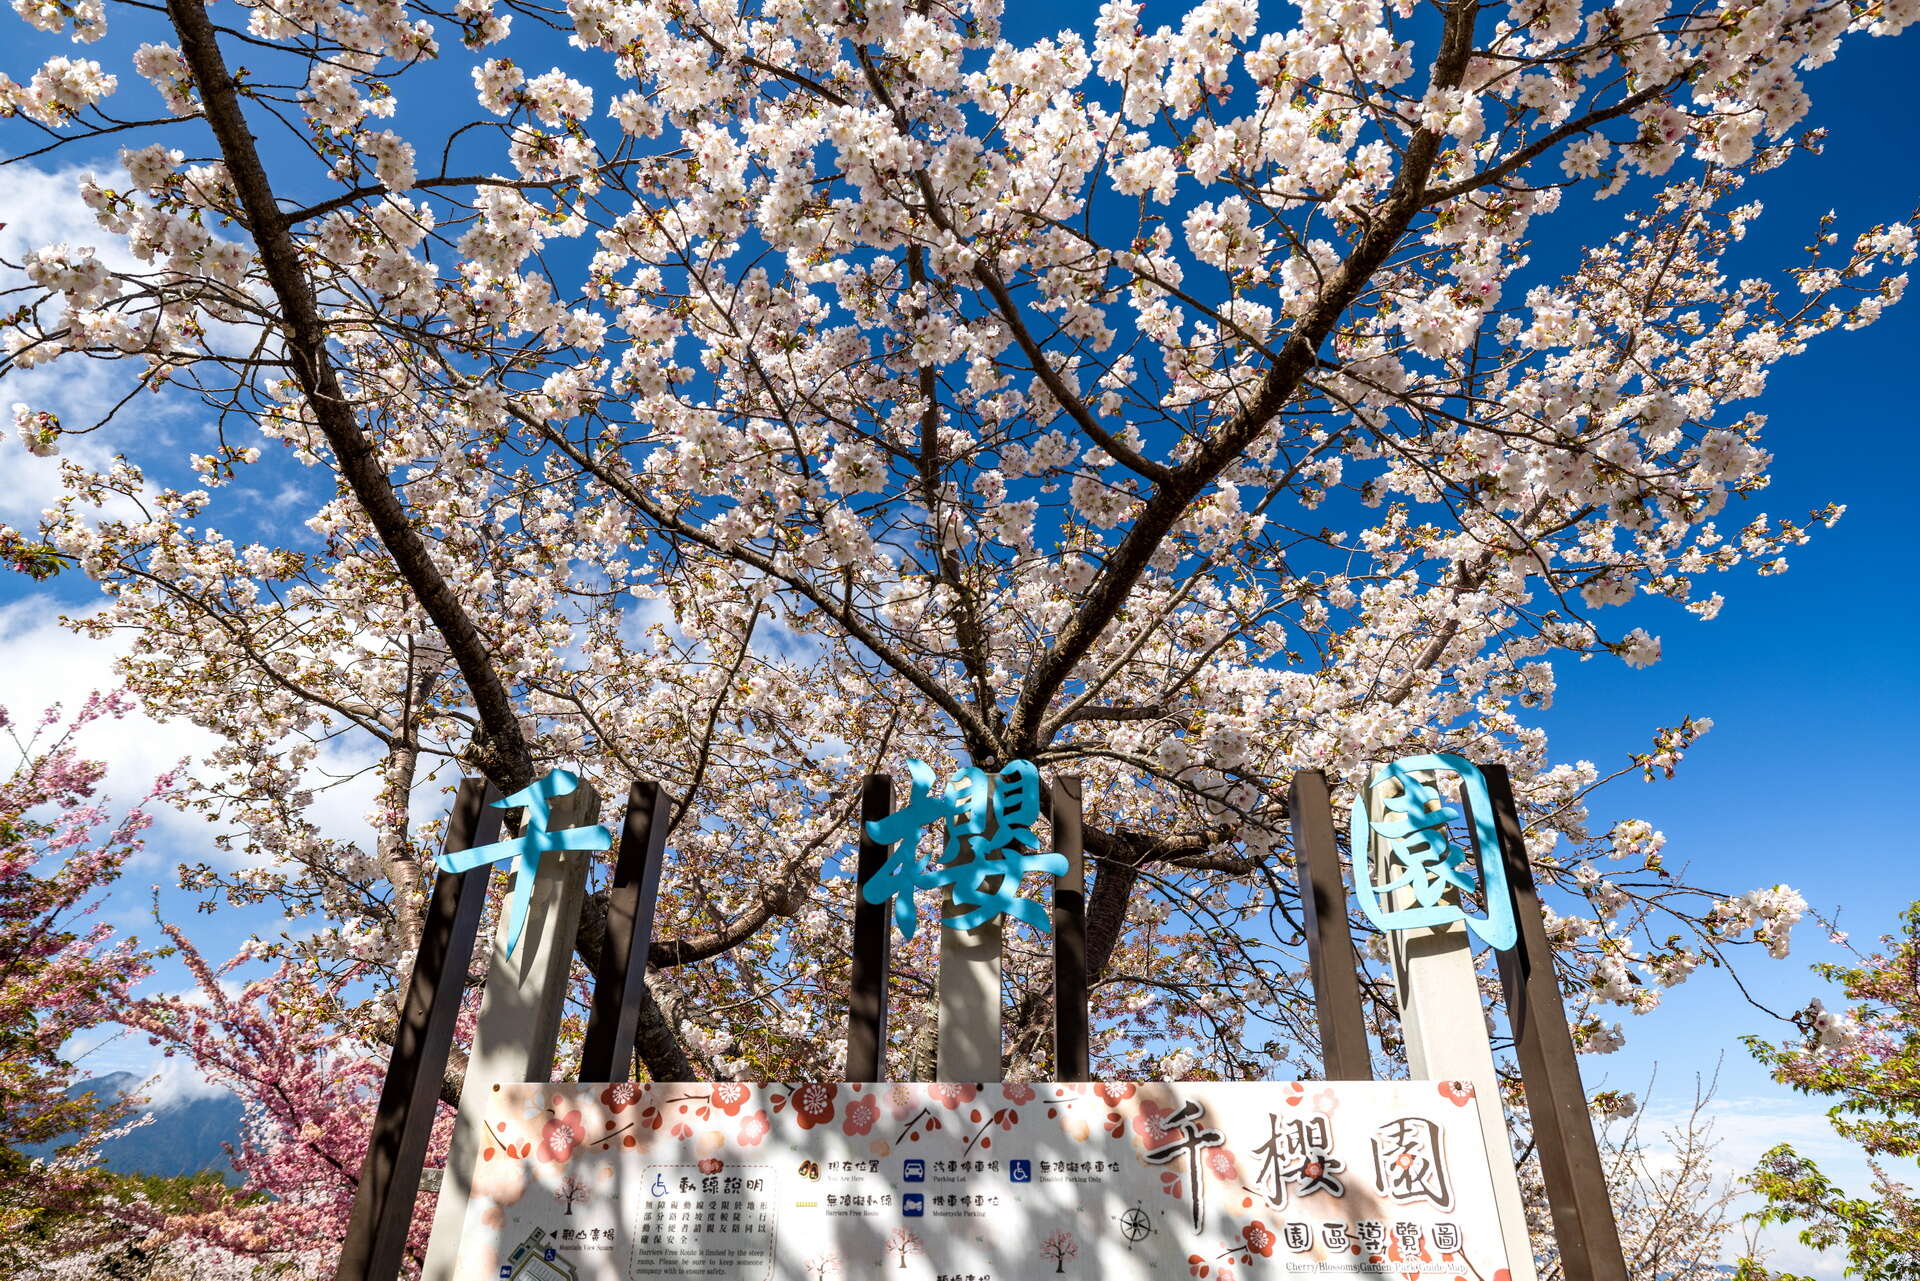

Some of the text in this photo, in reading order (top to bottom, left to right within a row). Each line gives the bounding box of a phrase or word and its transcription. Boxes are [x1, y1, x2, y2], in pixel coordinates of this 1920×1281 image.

[827, 1159, 880, 1173] 現在位置
[1145, 1100, 1451, 1232] 千櫻園
[1284, 1222, 1458, 1251] 園區導覽圖
[719, 1258, 734, 1266] keep
[1360, 1262, 1392, 1272] Garden
[664, 1267, 678, 1275] with
